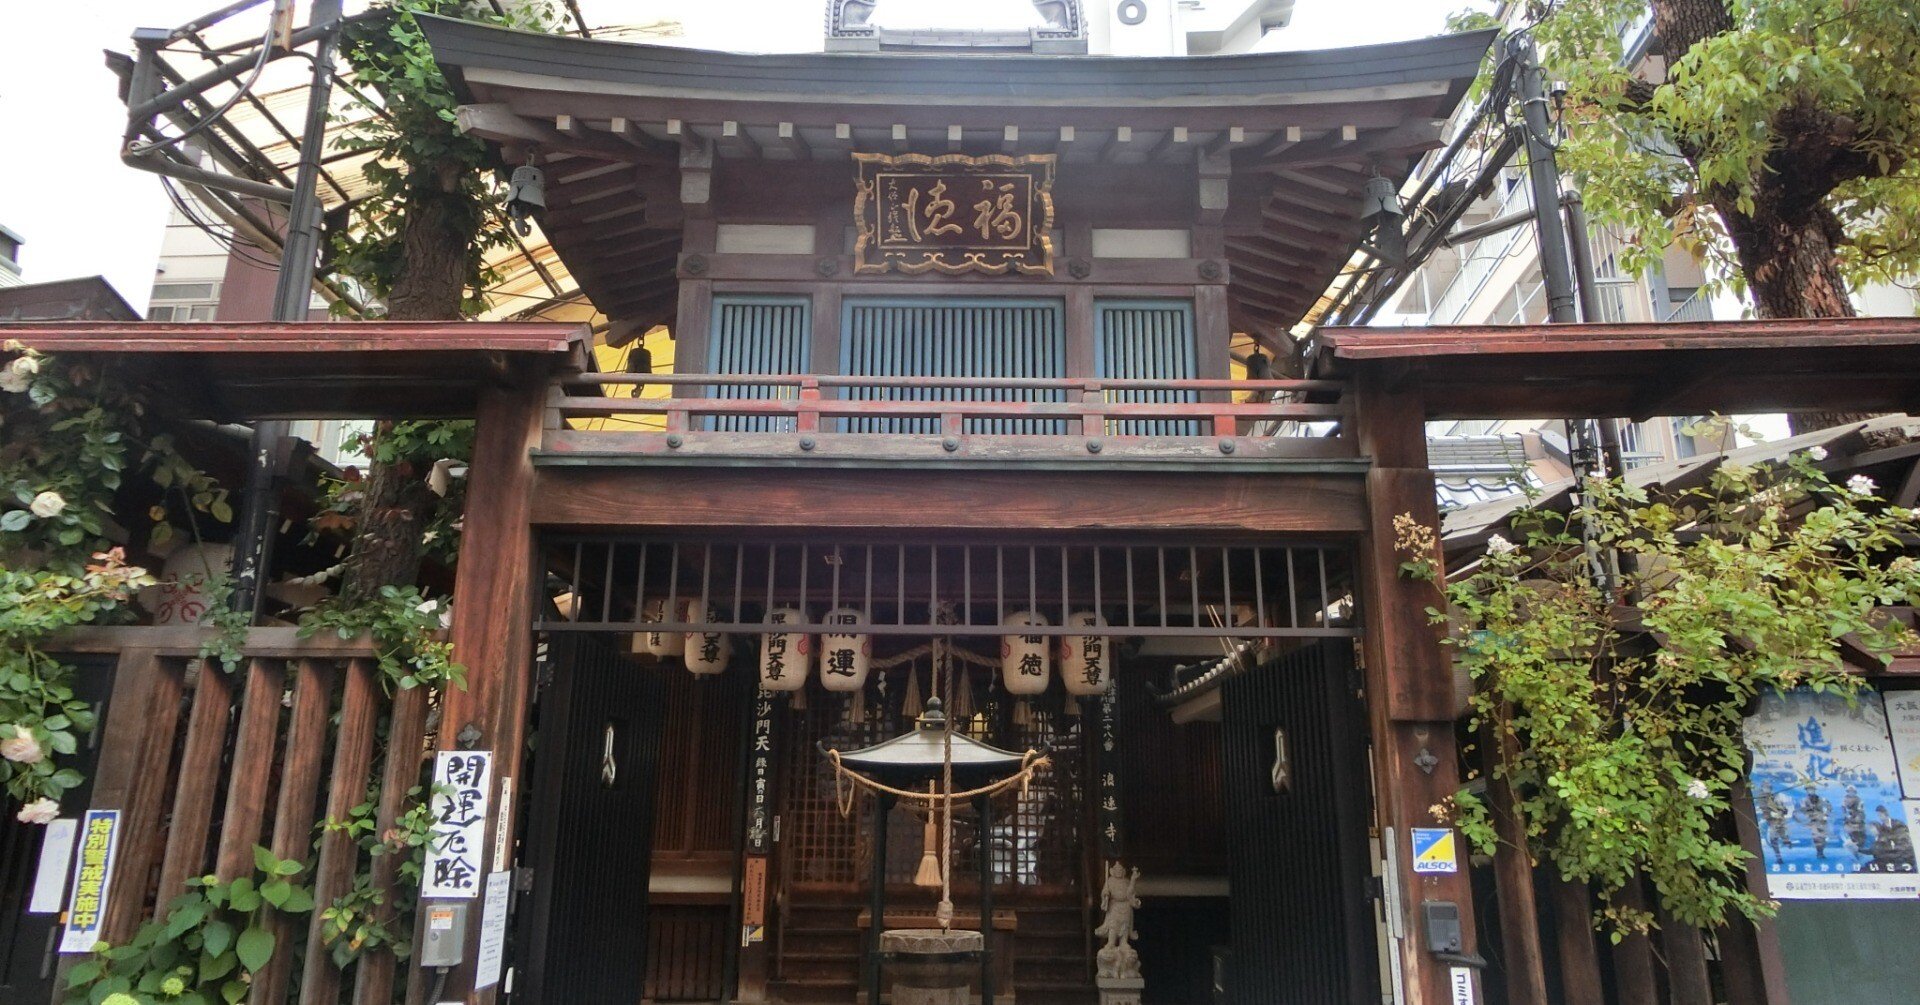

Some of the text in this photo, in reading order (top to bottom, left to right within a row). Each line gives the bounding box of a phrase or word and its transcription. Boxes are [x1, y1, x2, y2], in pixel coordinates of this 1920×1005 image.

[73, 817, 113, 930] 特別警戒実施中
[432, 754, 485, 889] 開運厄除
[1416, 861, 1454, 870] ALSOK
